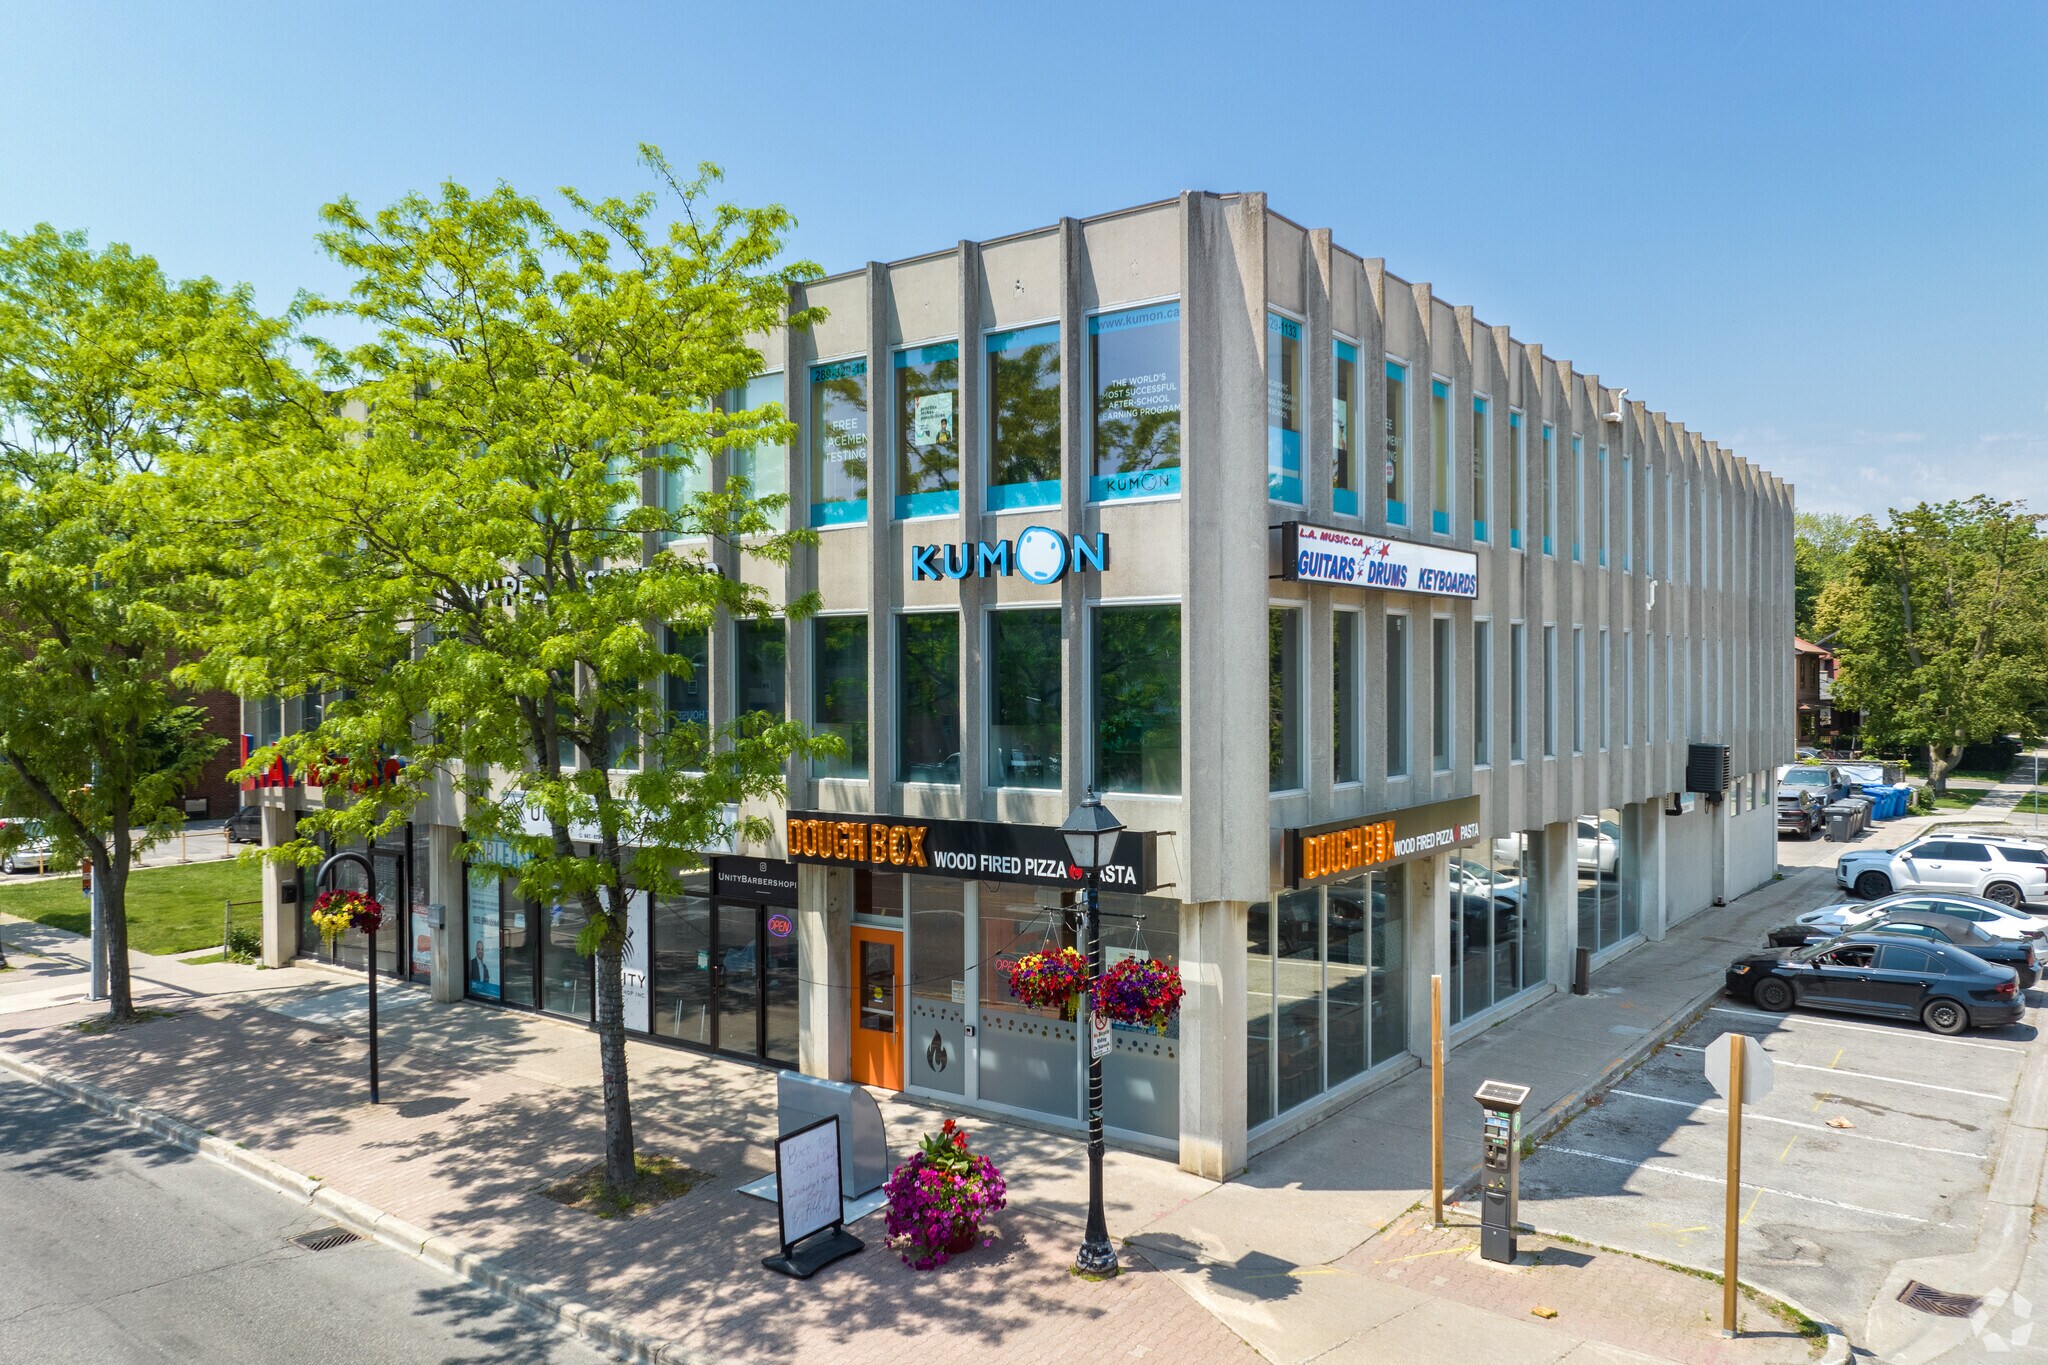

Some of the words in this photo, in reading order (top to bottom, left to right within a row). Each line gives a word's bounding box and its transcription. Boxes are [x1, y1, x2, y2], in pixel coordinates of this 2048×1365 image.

[1097, 308, 1180, 330] www.kumon.ca
[1111, 378, 1127, 388] THE
[1129, 372, 1167, 386] WORLD'S
[1125, 382, 1177, 397] SUCCESSFUL
[1108, 394, 1170, 410] AFTER-SCHOOL
[1140, 403, 1180, 416] PROGRAM
[832, 418, 858, 431] FREE
[825, 448, 867, 463] TESTING
[1107, 473, 1169, 493] KUMON
[1299, 528, 1317, 540] L.A.
[1320, 531, 1364, 548] MUSIC.CA
[912, 525, 1110, 586] KUMON
[1298, 549, 1356, 581] GUITARS
[1367, 560, 1408, 588] DRUMS
[1418, 567, 1476, 595] KEYBOARDS
[787, 818, 868, 862] DOUGH
[871, 823, 928, 868] BOX
[934, 850, 977, 870] WOOD
[980, 854, 1022, 875] FIRED
[1025, 858, 1068, 879] PIZZA
[1099, 865, 1137, 885] ASTA
[1303, 828, 1361, 879] DOUGH
[1361, 820, 1396, 865] BOX
[1394, 837, 1415, 857] WOOD
[1416, 832, 1435, 852] FIRED
[1436, 828, 1455, 847] PIZZA
[1460, 822, 1479, 840] PASTA
[769, 919, 790, 932] OPEN
[995, 958, 1016, 973] OPE
[623, 972, 646, 988] ITY
